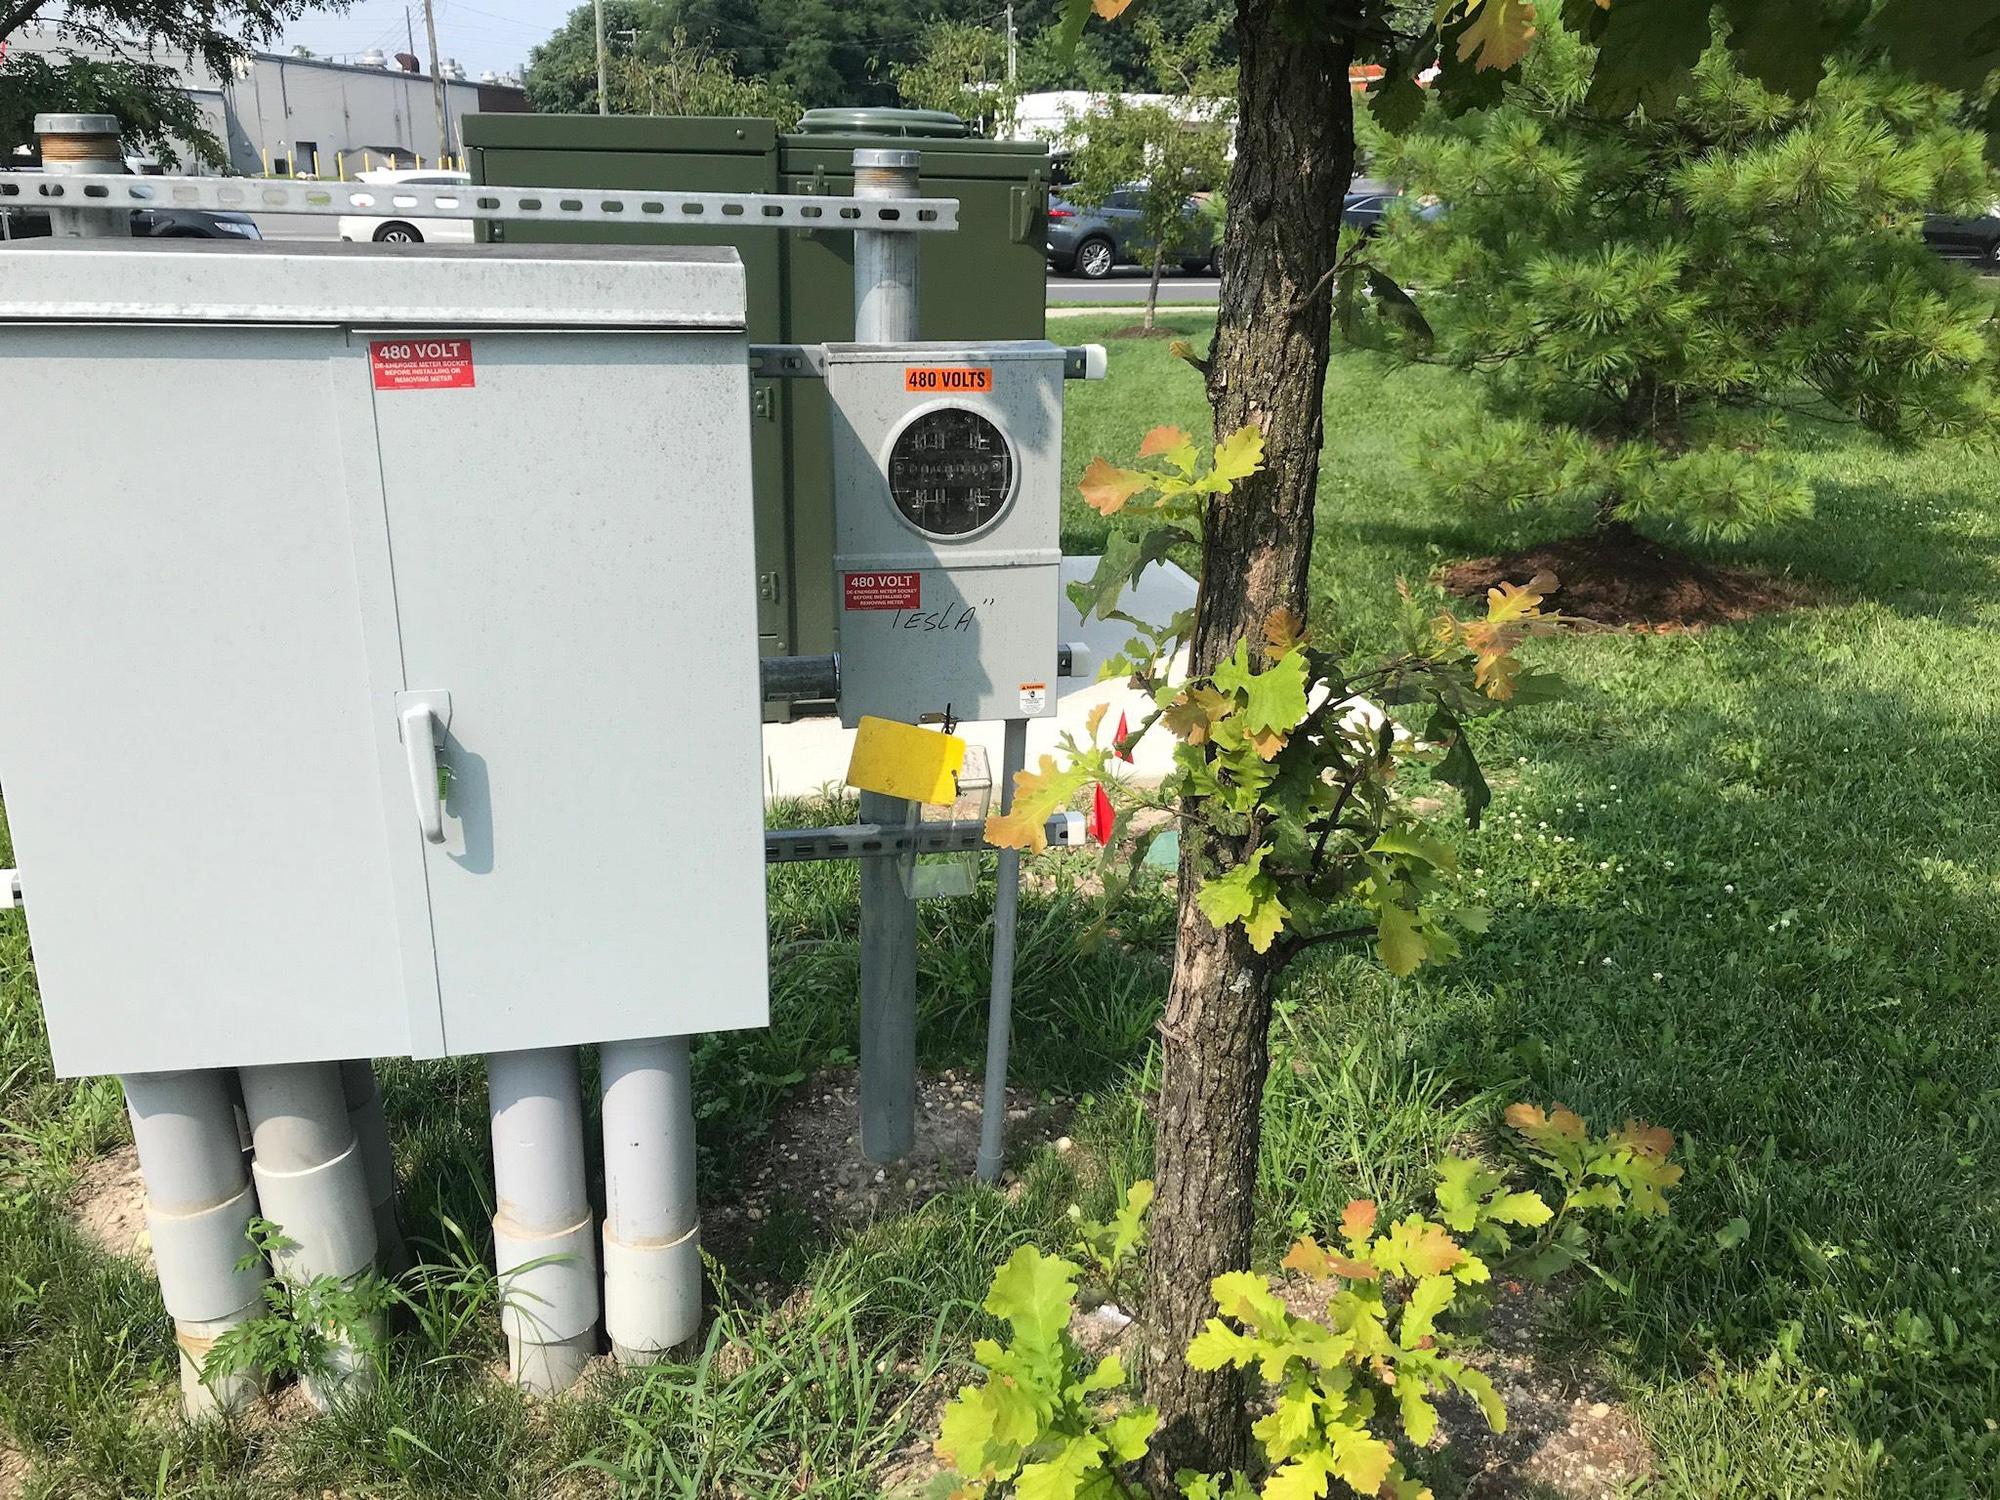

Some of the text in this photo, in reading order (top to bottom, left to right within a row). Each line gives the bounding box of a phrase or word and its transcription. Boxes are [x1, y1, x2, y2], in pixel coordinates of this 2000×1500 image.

[379, 343, 461, 359] 480 VOLT
[908, 371, 985, 387] 480 VOLTS
[851, 575, 913, 587] 480 VOLT
